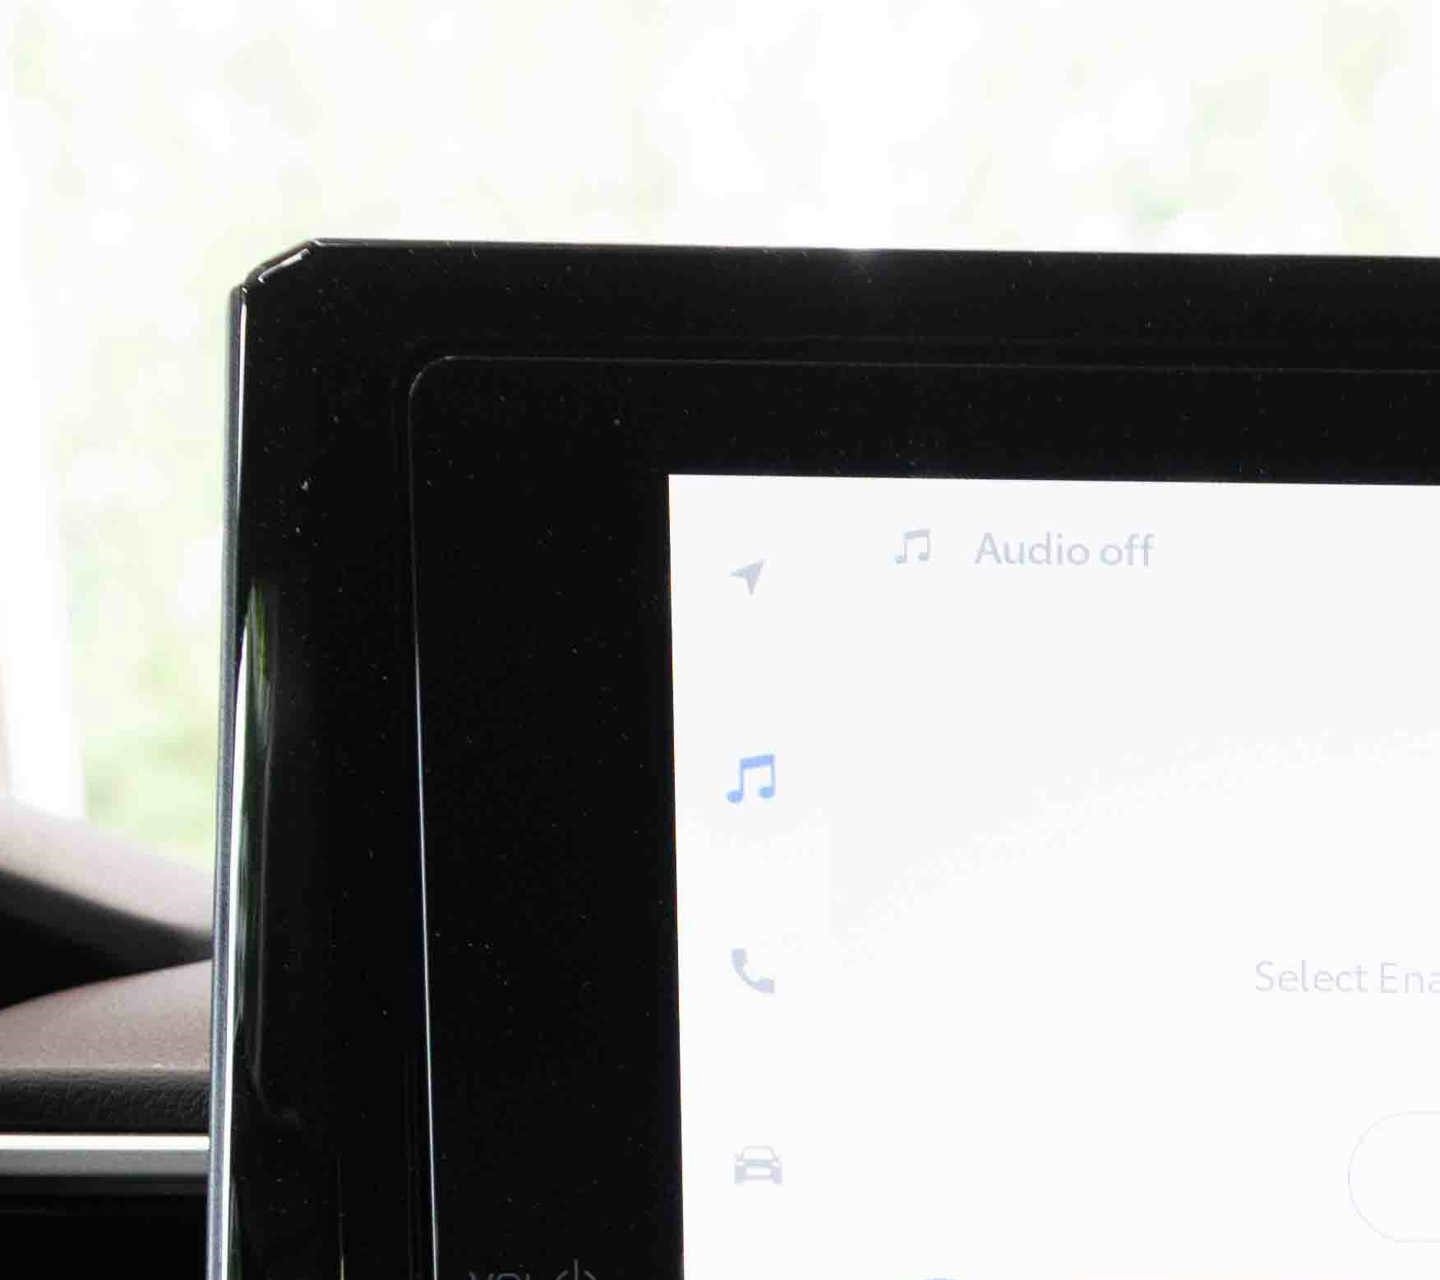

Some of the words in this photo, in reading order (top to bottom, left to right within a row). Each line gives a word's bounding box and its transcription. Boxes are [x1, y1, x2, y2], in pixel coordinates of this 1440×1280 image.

[973, 531, 1089, 567] Audio
[1099, 531, 1155, 567] off
[1254, 959, 1368, 995] Select
